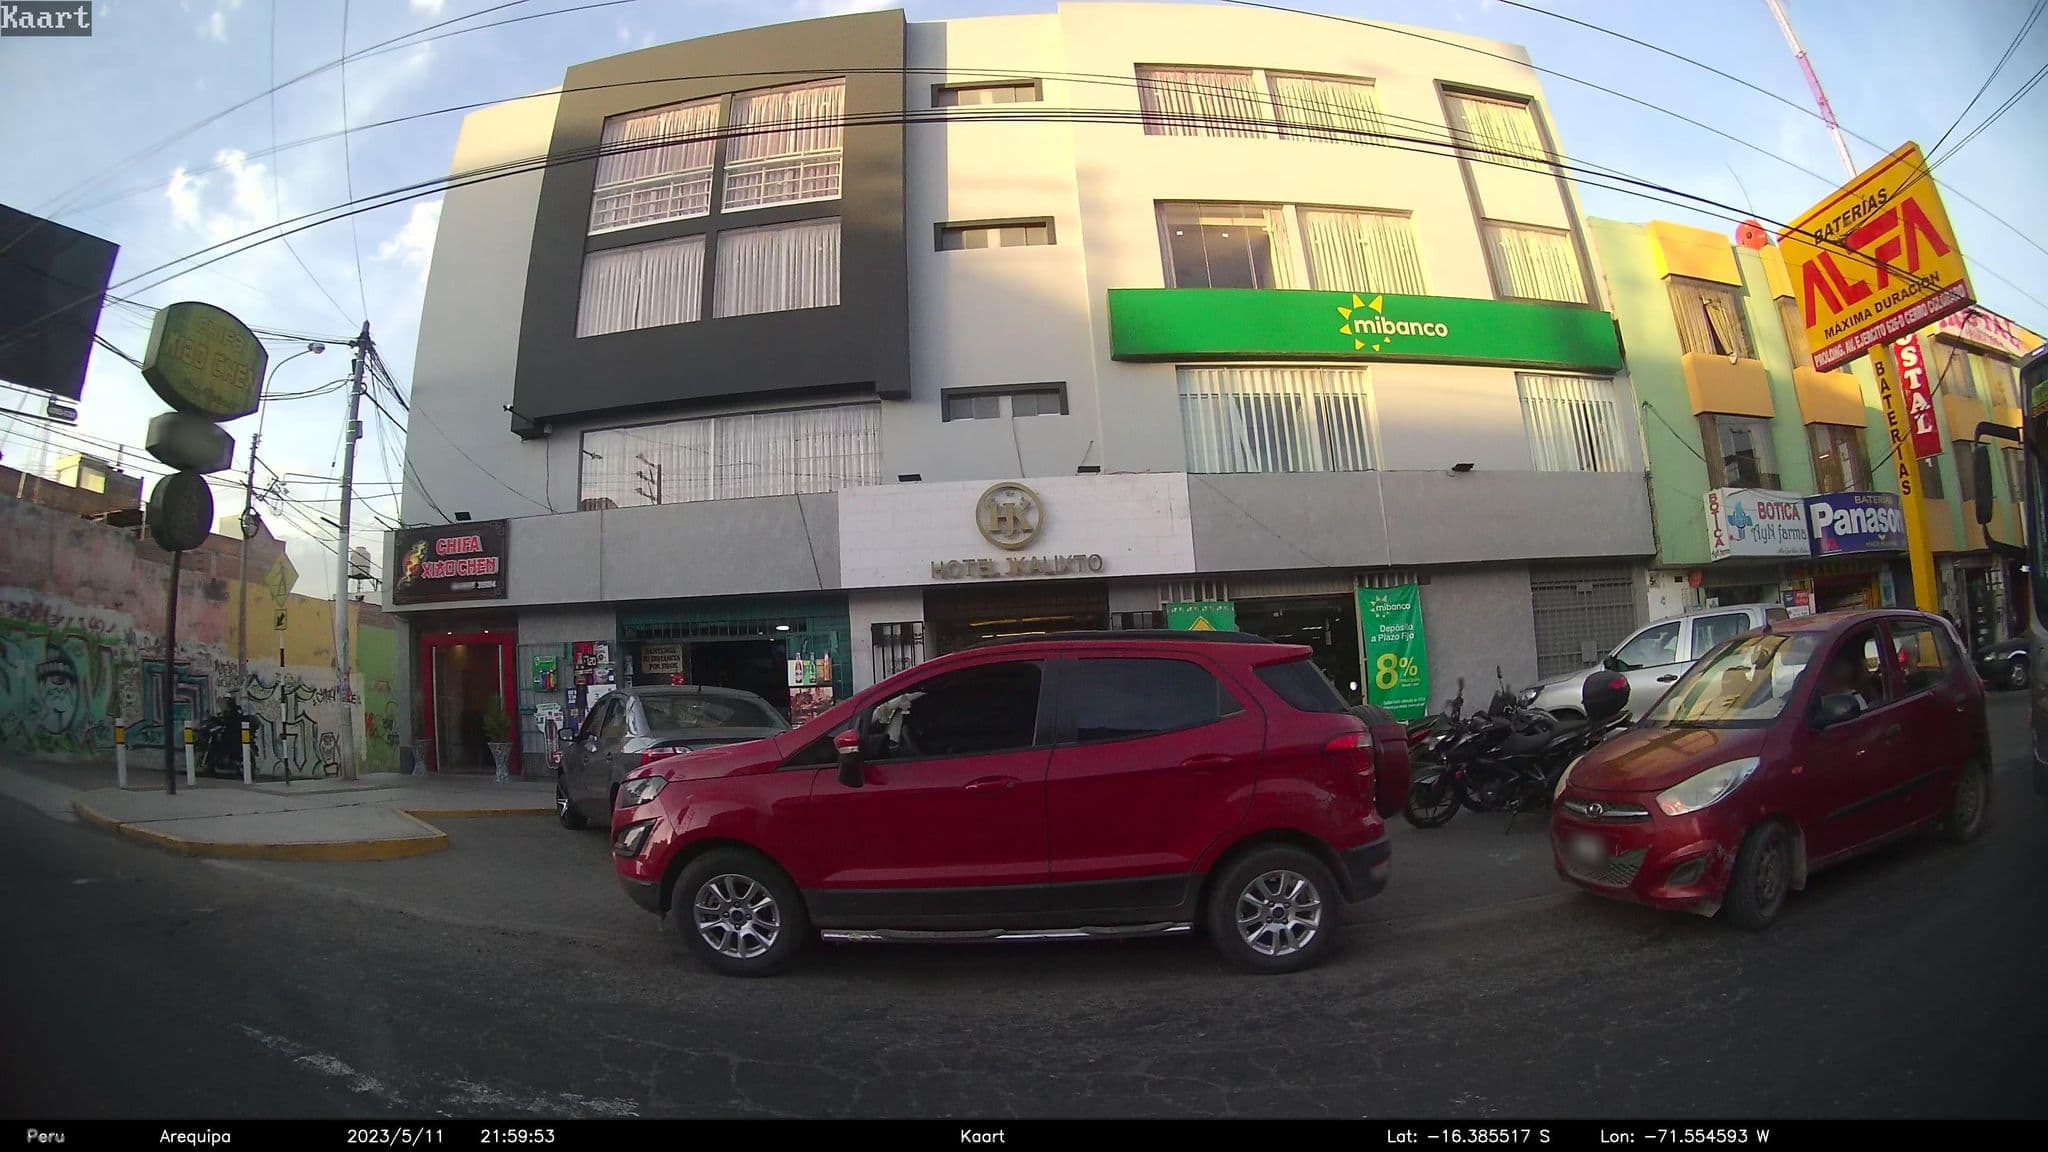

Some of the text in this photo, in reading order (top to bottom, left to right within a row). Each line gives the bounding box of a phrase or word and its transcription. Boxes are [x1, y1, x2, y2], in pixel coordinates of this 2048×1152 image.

[1802, 197, 1951, 329] ALFA
[1353, 316, 1448, 337] mibanco
[1824, 308, 1873, 340] MÁXIMA
[1895, 333, 1932, 434] STAL
[1874, 360, 1911, 496] BATERIAS
[1708, 493, 1725, 548] BOTICA
[1757, 501, 1800, 520] BOTICA
[1809, 502, 1904, 539] Panason
[435, 535, 483, 555] CHIFA
[421, 557, 499, 579] XIAO CHEN
[930, 557, 998, 580] HOTEL
[1375, 602, 1411, 612] mibanco
[1378, 633, 1400, 641] Plazo
[1375, 653, 1418, 690] 8%
